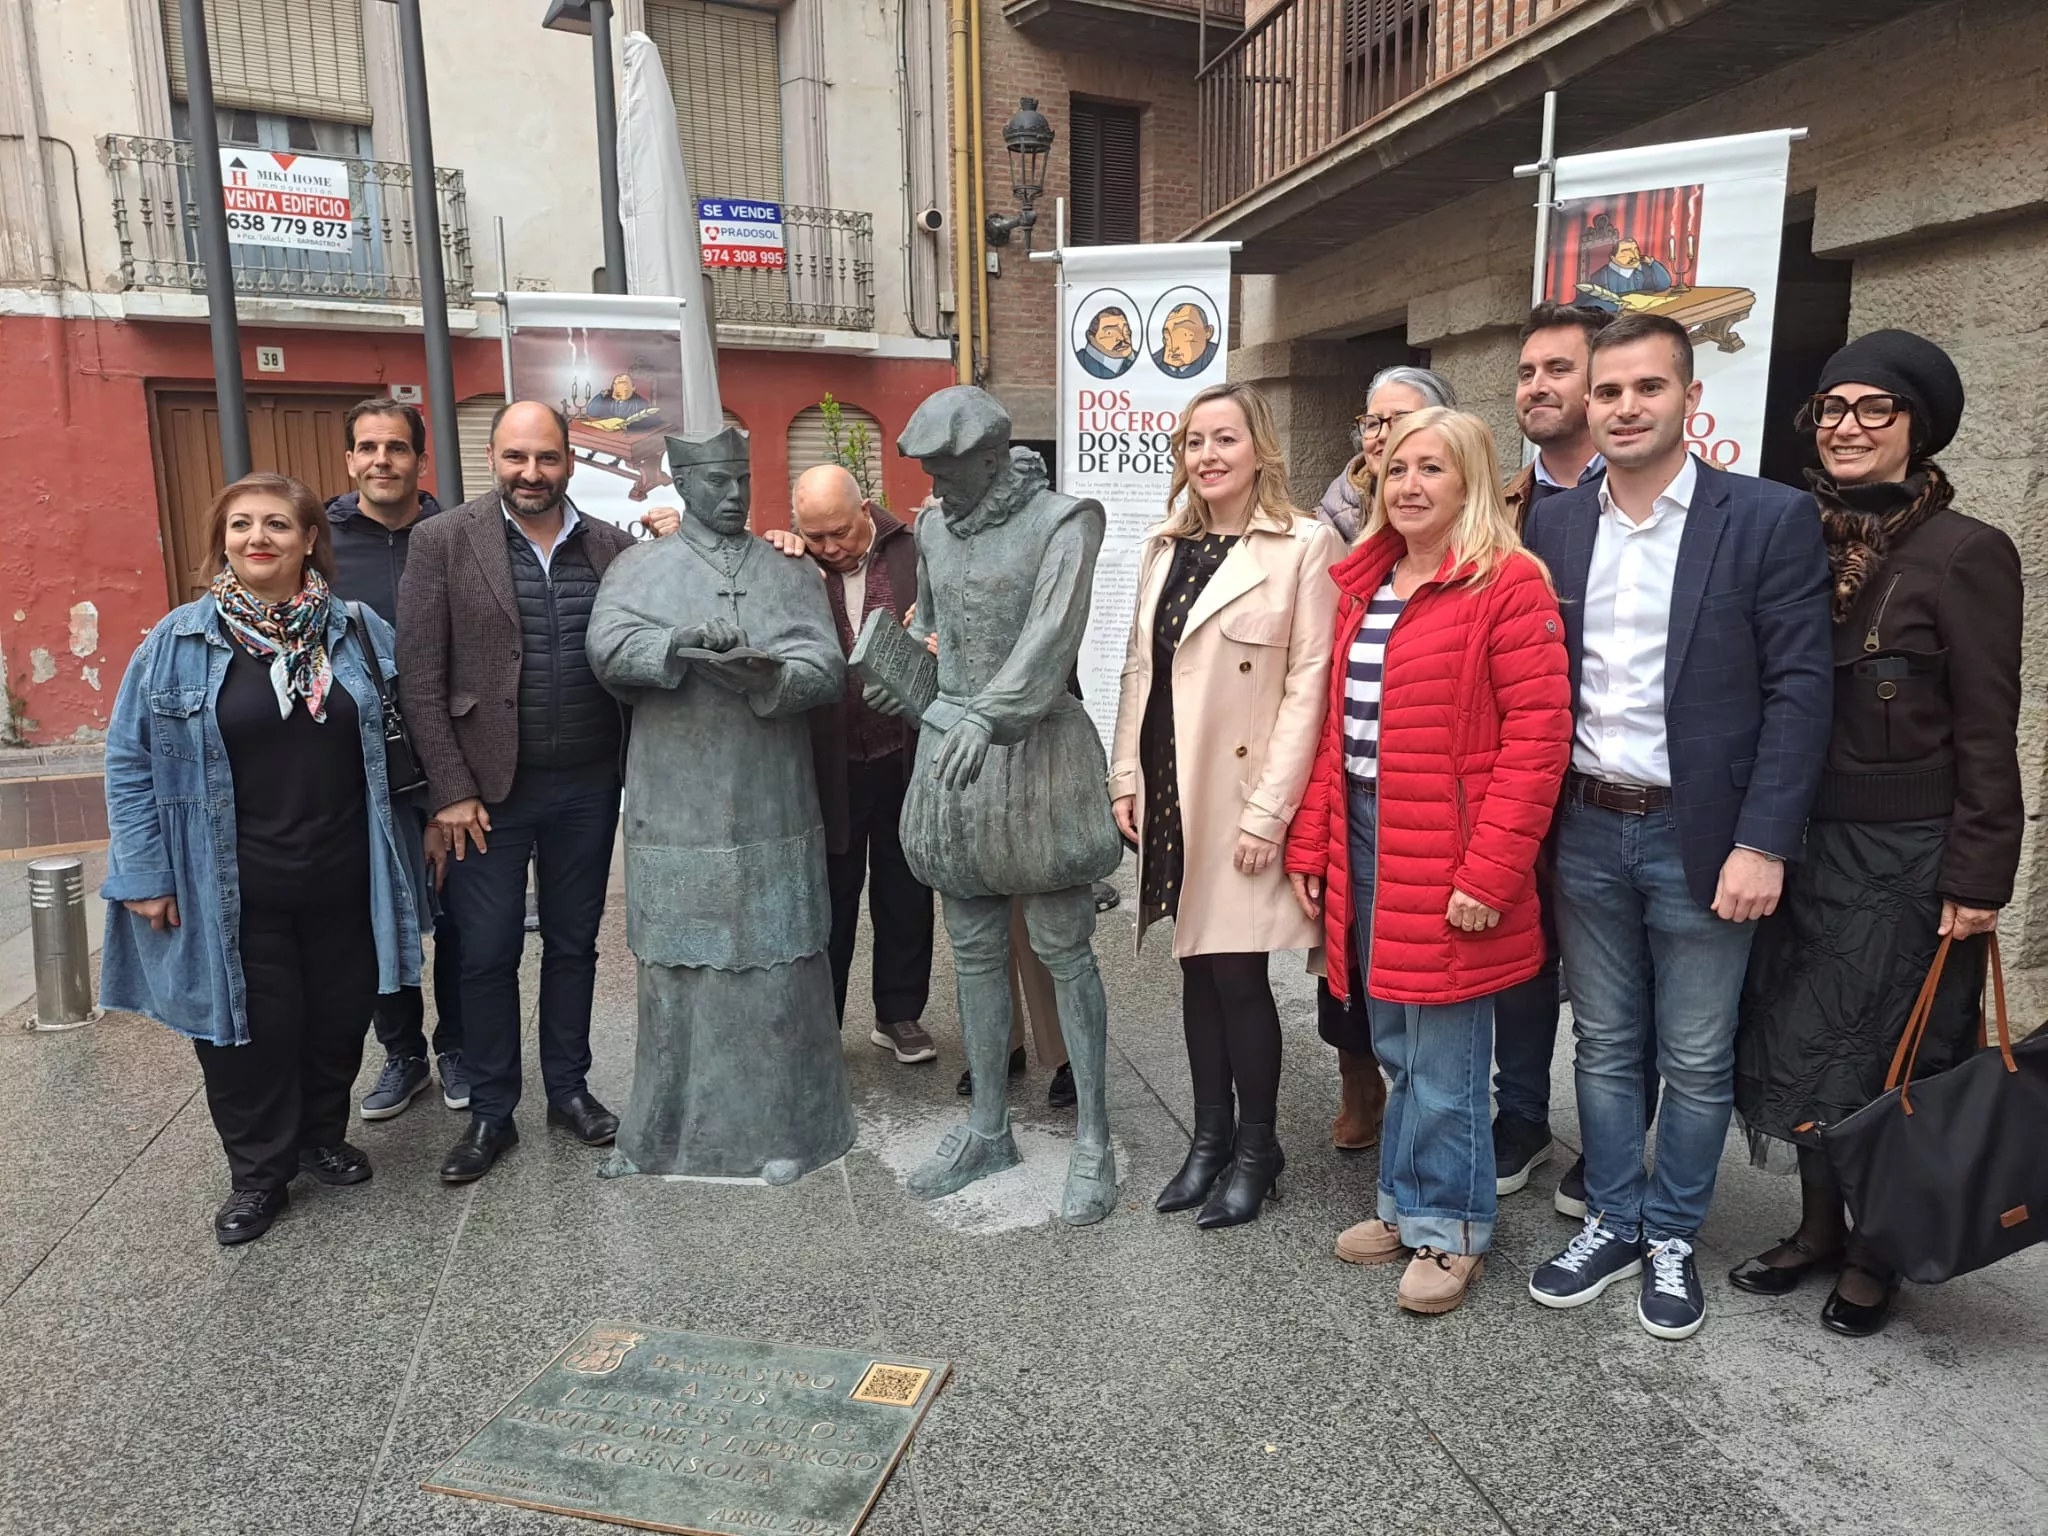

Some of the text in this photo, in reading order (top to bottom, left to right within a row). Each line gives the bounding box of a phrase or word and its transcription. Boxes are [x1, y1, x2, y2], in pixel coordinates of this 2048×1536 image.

[257, 170, 332, 188] MIKI HOME
[224, 188, 346, 218] VENTA EDIFICIO
[703, 204, 776, 220] SE VENDE
[227, 212, 348, 239] 638 779 873
[720, 227, 779, 240] PRADOSOL
[703, 248, 783, 265] 974 308 995
[262, 352, 279, 367] 38
[1078, 390, 1131, 411] DOS
[1078, 411, 1184, 432] LUCERO
[1078, 432, 1172, 453] DOS SO
[1684, 439, 1741, 467] DO
[1078, 453, 1176, 475] DE POES
[651, 1353, 837, 1390] BARBASTRO
[680, 1381, 771, 1407] A SUS
[561, 1386, 858, 1443] ILUSTRES HIJOS
[564, 1439, 772, 1484] ARGENSOLA
[700, 1431, 721, 1448] Y
[720, 1434, 880, 1472] LUPERCIO
[706, 1507, 777, 1531] ABRIL
